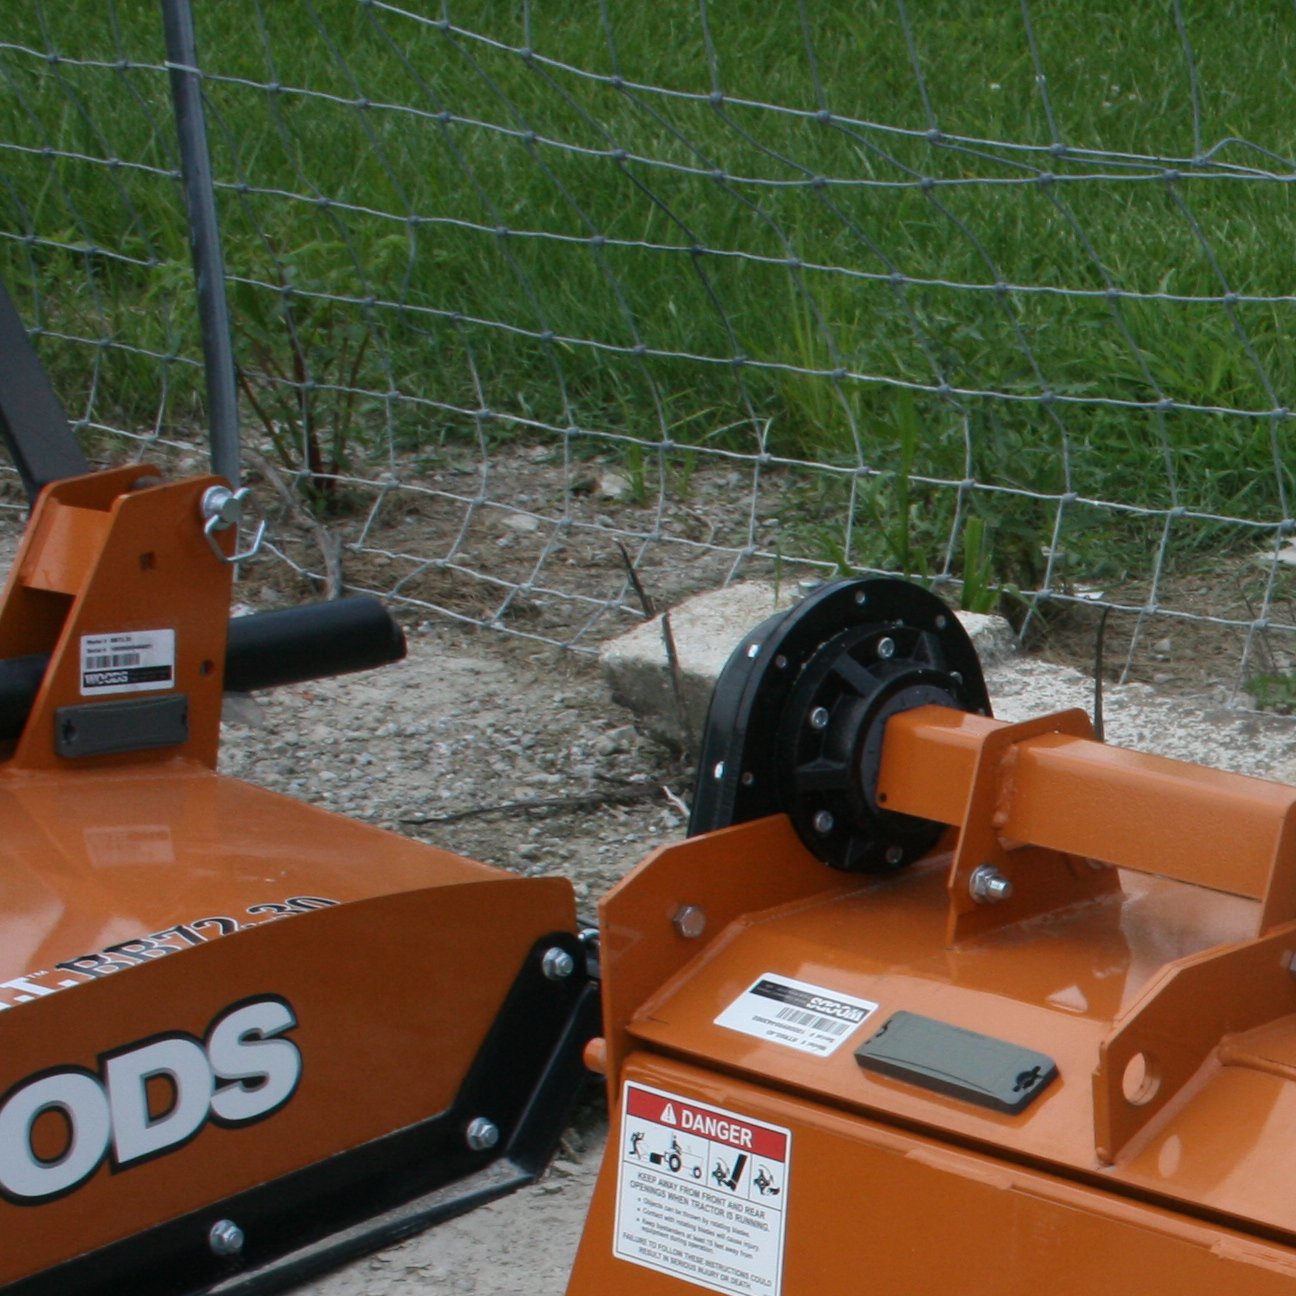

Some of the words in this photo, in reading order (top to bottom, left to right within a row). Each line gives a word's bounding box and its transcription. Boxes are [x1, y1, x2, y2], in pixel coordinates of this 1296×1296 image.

[55, 896, 340, 981] BB723
[806, 997, 864, 1021] WOODS
[681, 1109, 752, 1148] DANGER
